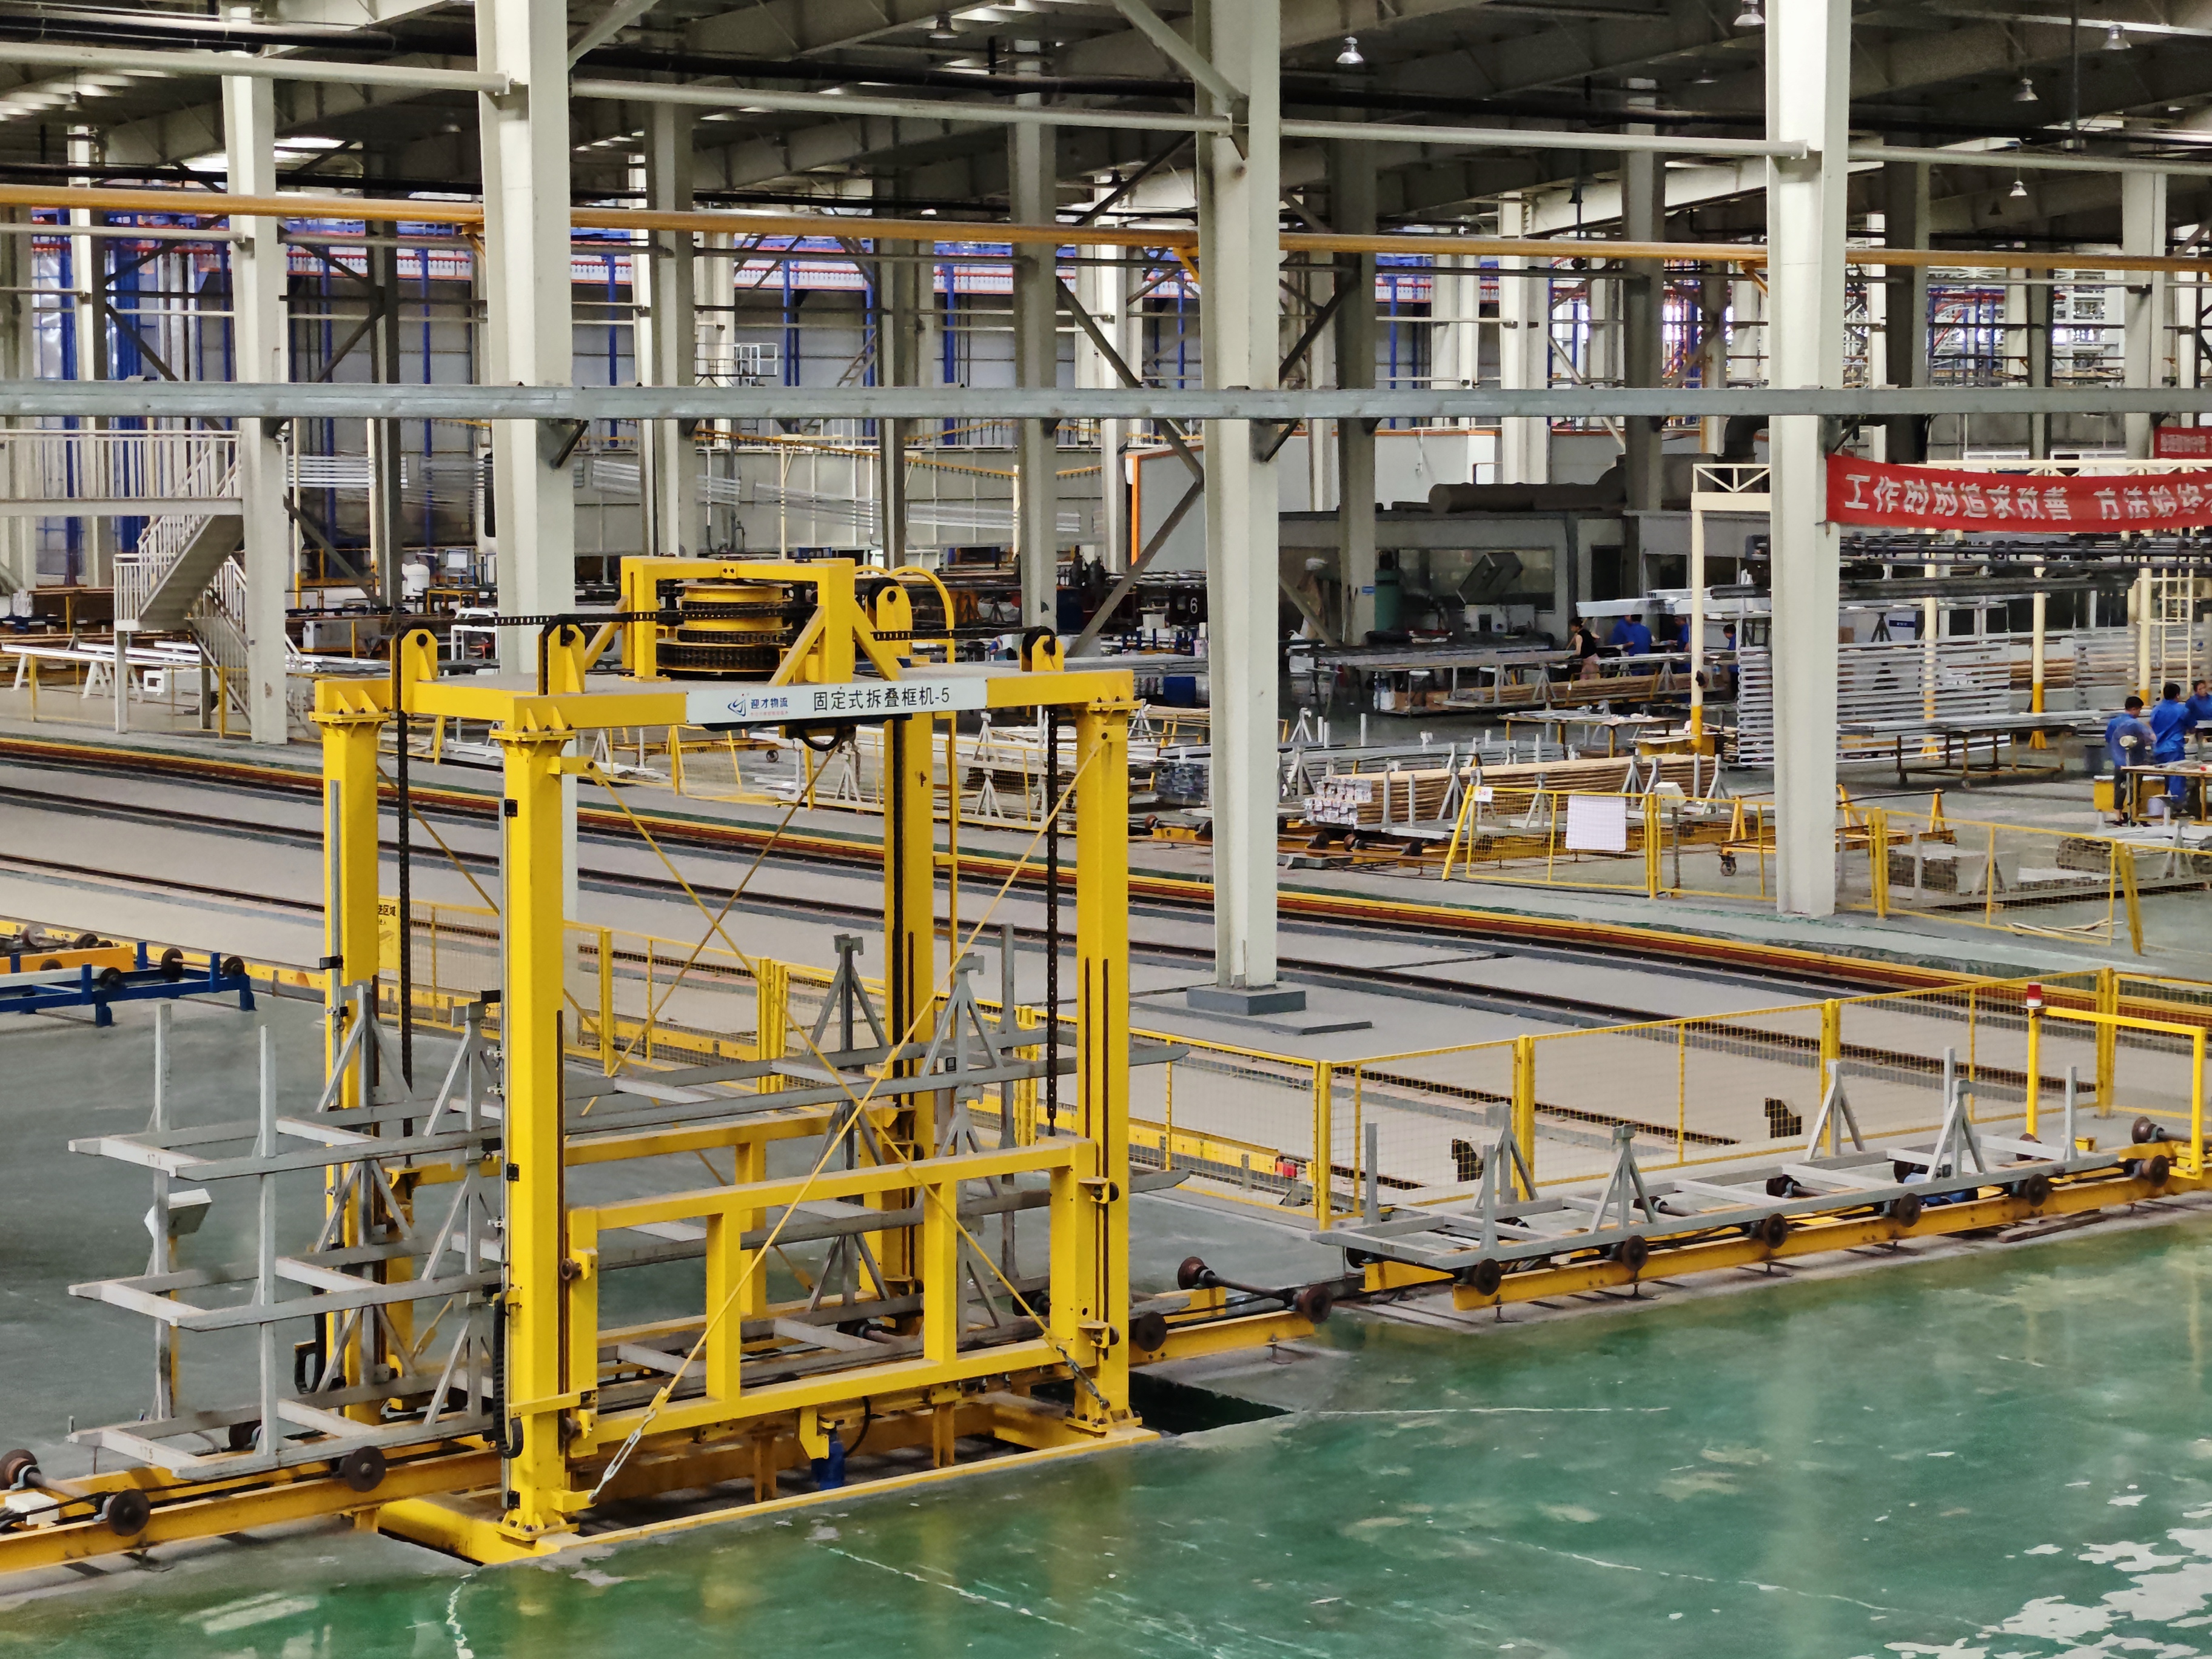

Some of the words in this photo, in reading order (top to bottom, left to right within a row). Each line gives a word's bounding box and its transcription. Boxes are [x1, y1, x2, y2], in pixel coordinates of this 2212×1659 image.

[1845, 471, 2071, 520] 工作时时追求改善
[1190, 597, 1198, 614] 6
[814, 686, 950, 711] 固定式拆叠框机-5
